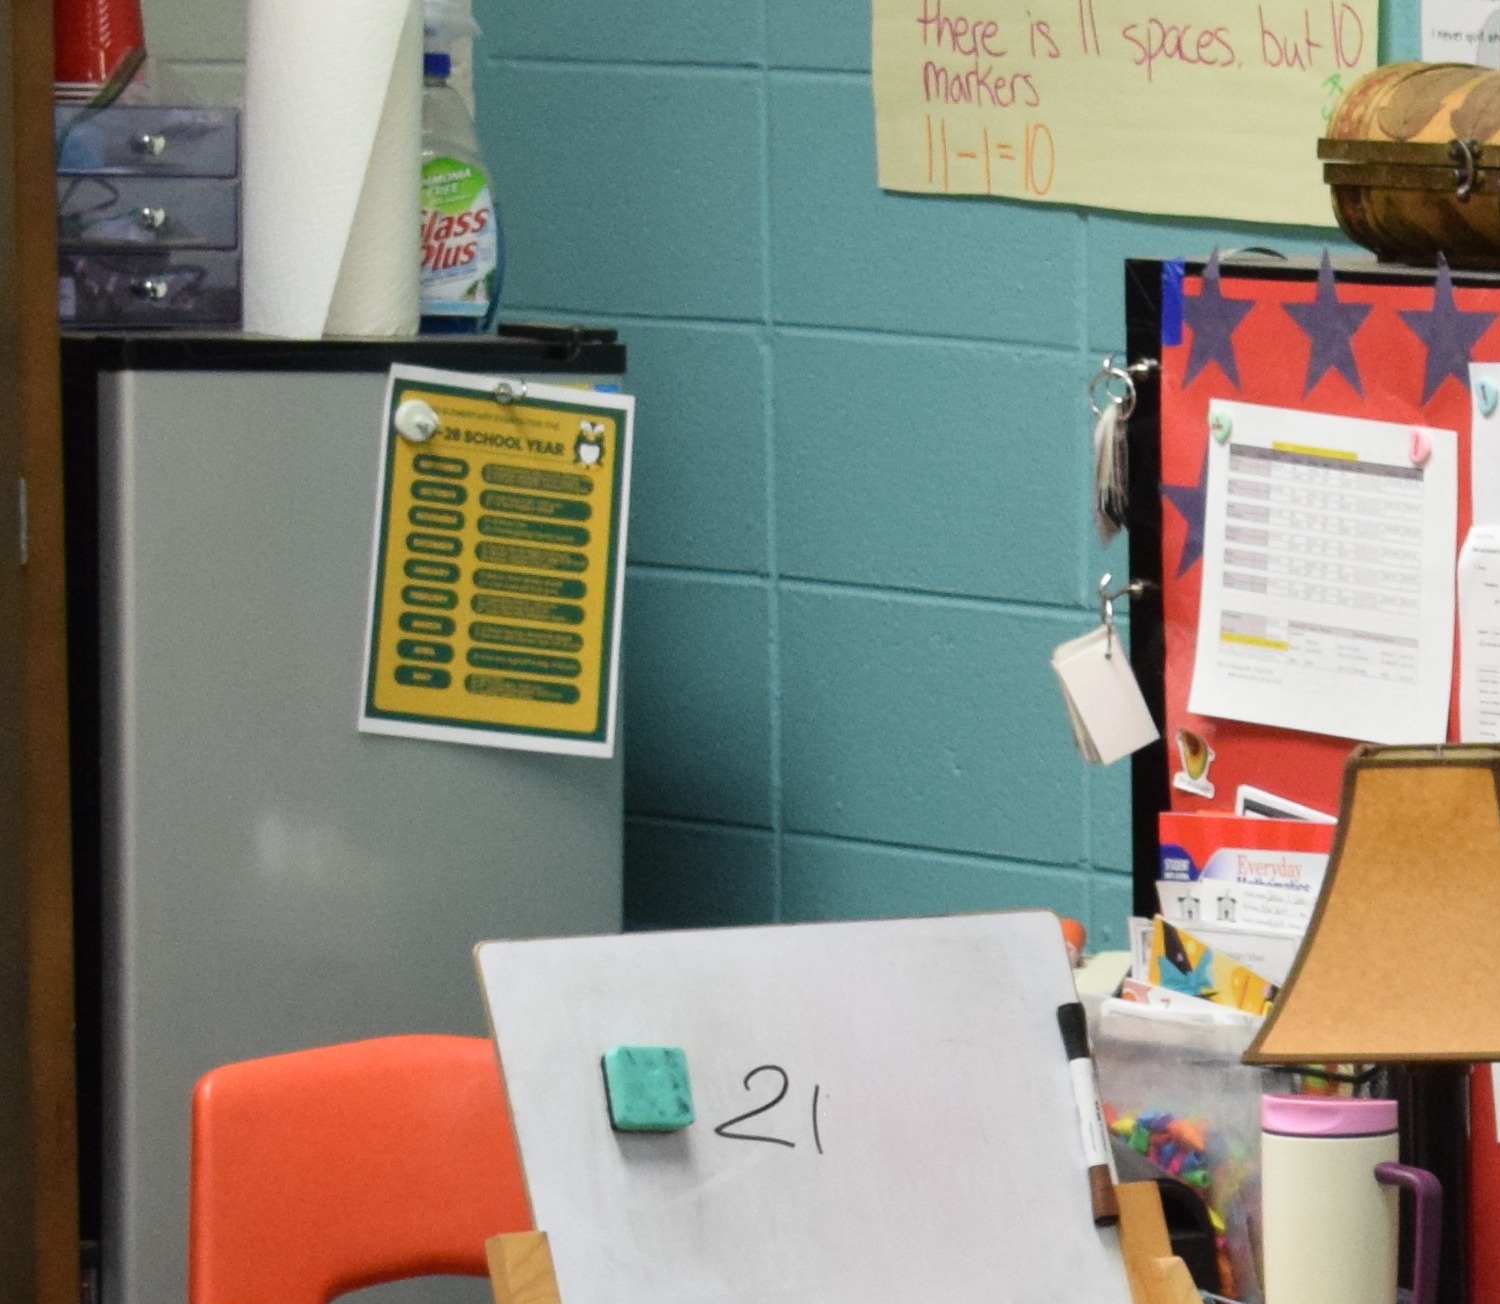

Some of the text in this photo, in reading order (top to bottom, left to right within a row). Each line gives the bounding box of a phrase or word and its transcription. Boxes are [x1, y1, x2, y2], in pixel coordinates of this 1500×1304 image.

[1026, 10, 1060, 58] is
[1258, 5, 1322, 70] but
[1330, 0, 1363, 69] 10
[464, 429, 523, 451] SCHOOL
[527, 437, 566, 456] YEAR
[1237, 854, 1303, 882] Everyday
